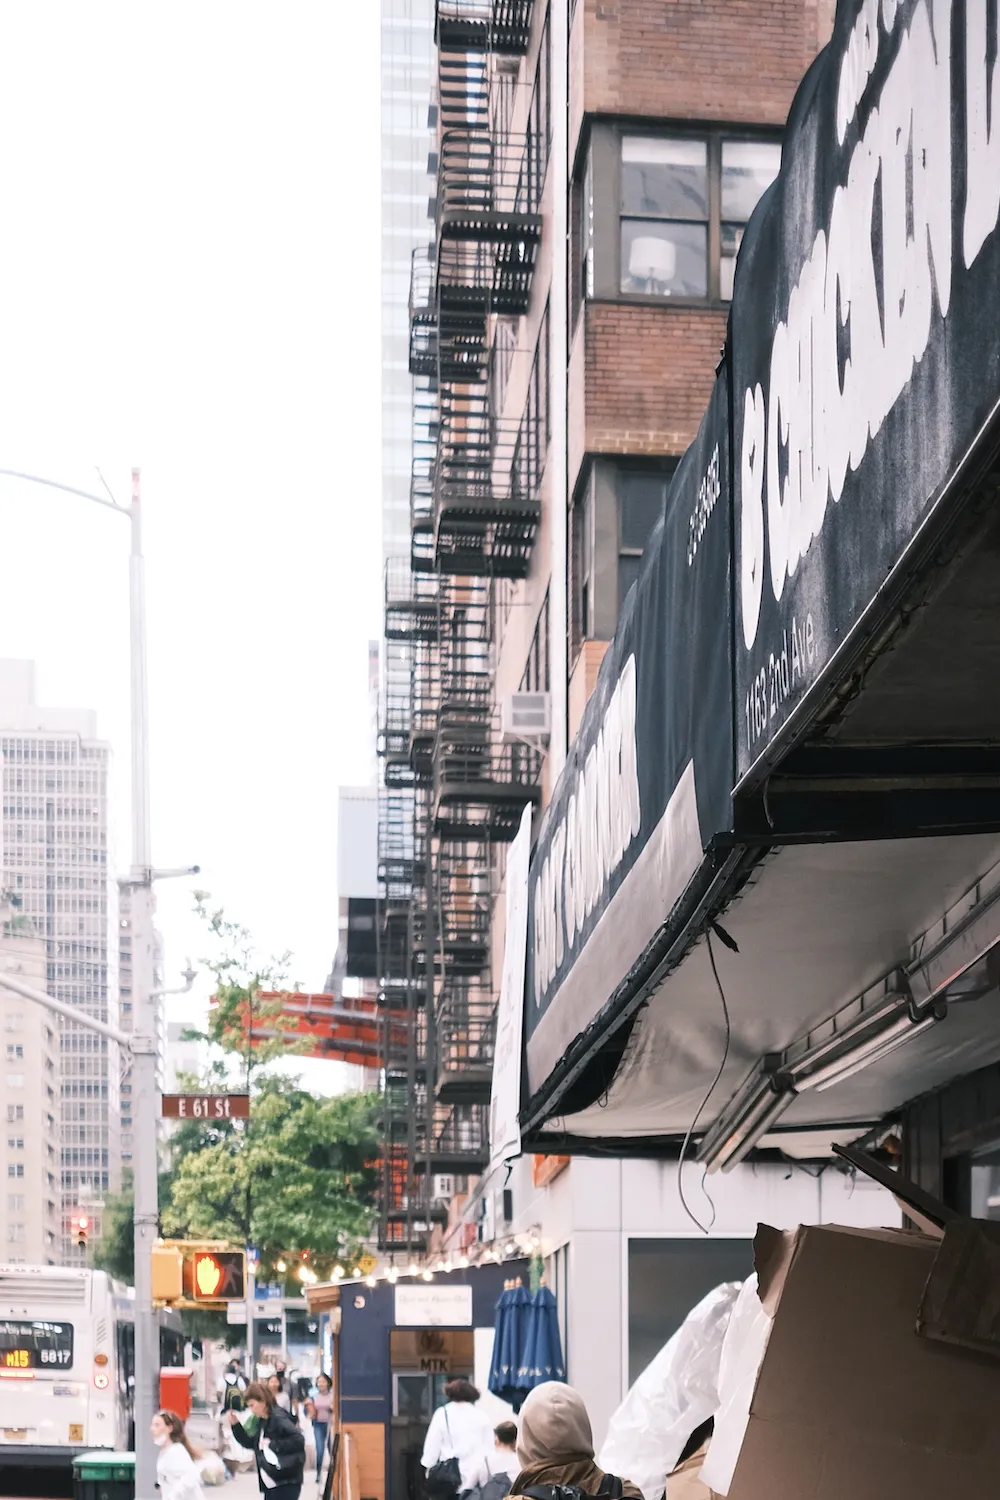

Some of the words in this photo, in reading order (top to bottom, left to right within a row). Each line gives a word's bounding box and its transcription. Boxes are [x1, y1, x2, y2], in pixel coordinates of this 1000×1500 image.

[745, 666, 768, 751] 1163
[769, 629, 791, 719] 2nd
[791, 612, 818, 686] Ave.
[178, 1098, 186, 1117] E
[193, 1098, 208, 1117] 61
[215, 1098, 230, 1117] St
[420, 1358, 448, 1371] MTK
